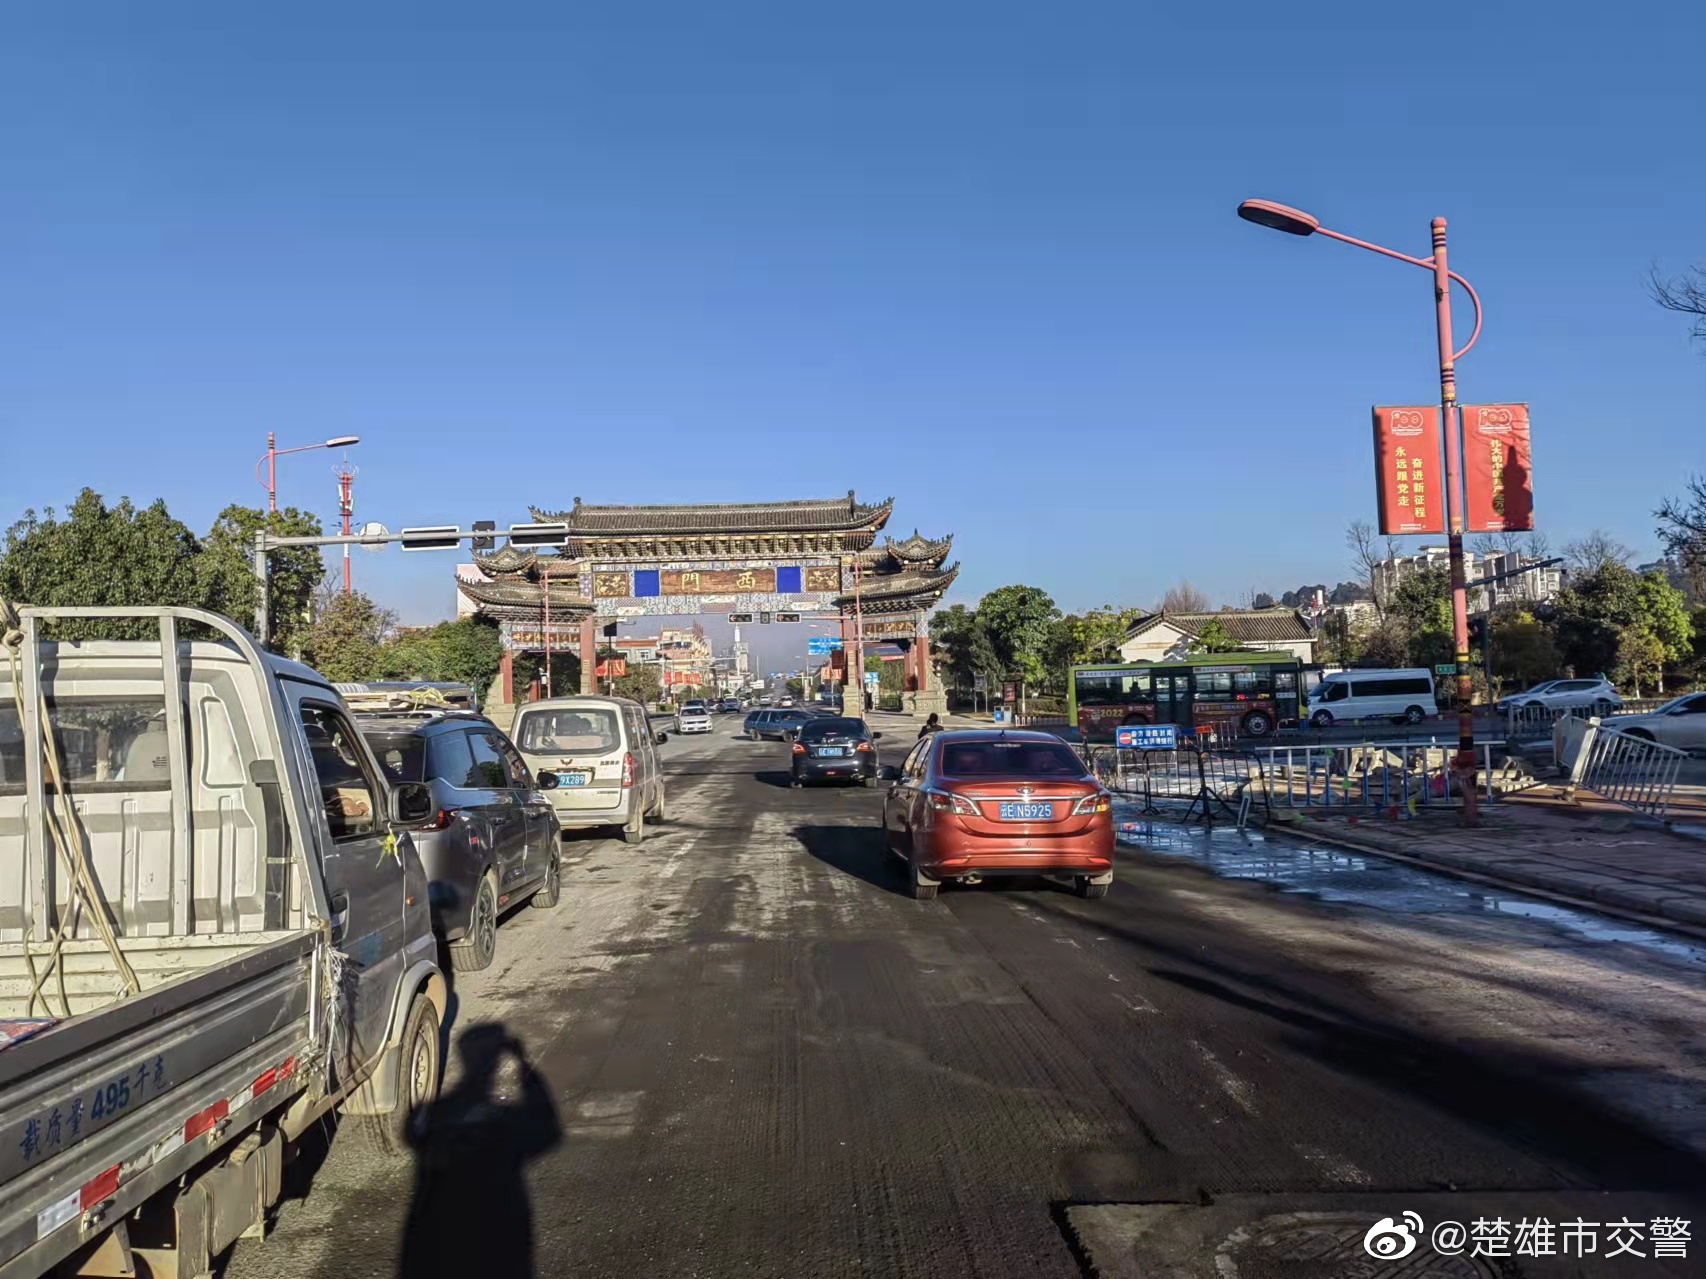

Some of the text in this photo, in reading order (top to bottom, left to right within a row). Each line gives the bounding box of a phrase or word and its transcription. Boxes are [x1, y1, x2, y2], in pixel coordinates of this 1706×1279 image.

[1395, 446, 1410, 507] 永远跟党走
[1411, 457, 1426, 518] 奋进新征程
[1100, 709, 1123, 718] 2022
